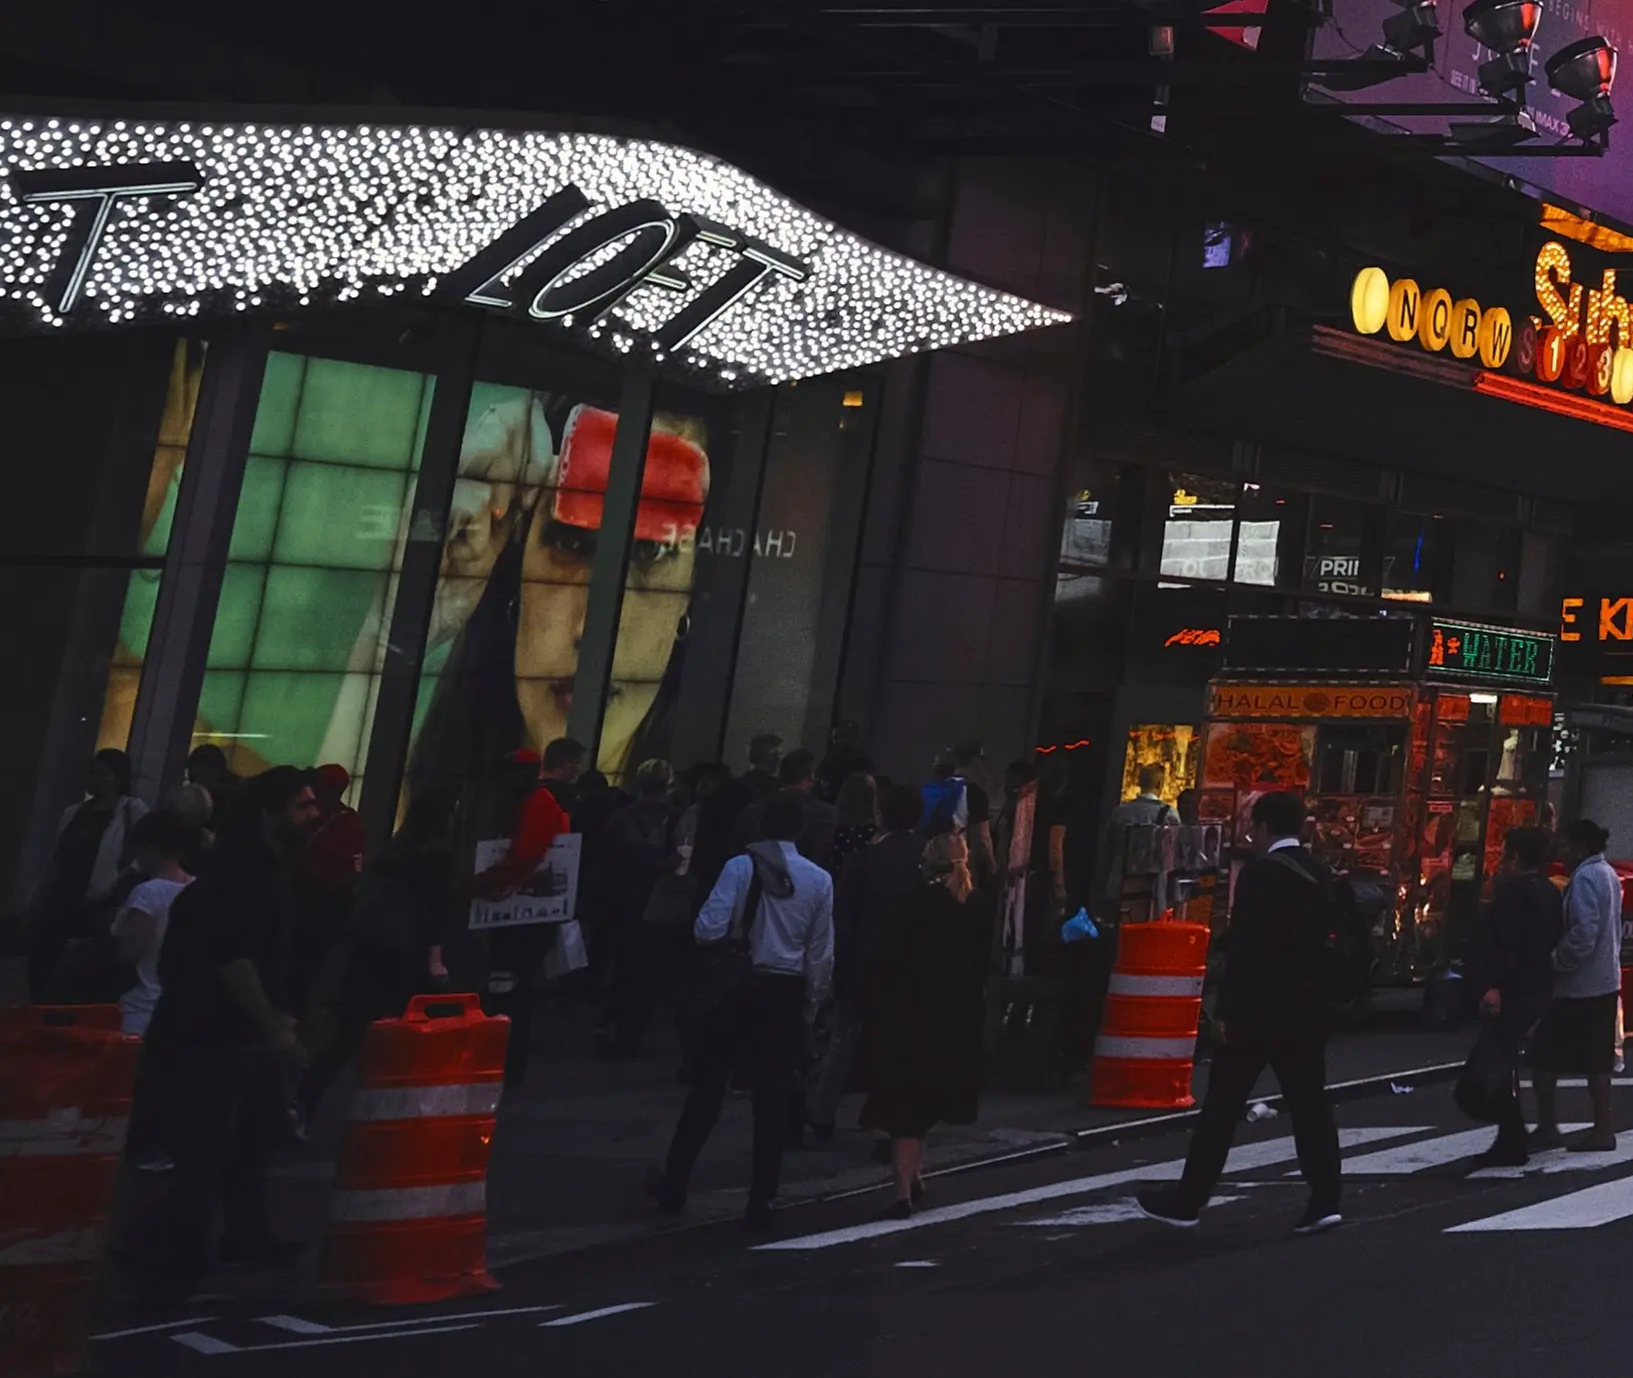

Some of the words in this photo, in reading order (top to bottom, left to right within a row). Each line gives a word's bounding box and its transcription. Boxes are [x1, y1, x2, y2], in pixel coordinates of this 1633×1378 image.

[458, 188, 806, 353] LOFT
[1217, 693, 1299, 711] HALAL
[1333, 693, 1407, 711] FOOD
